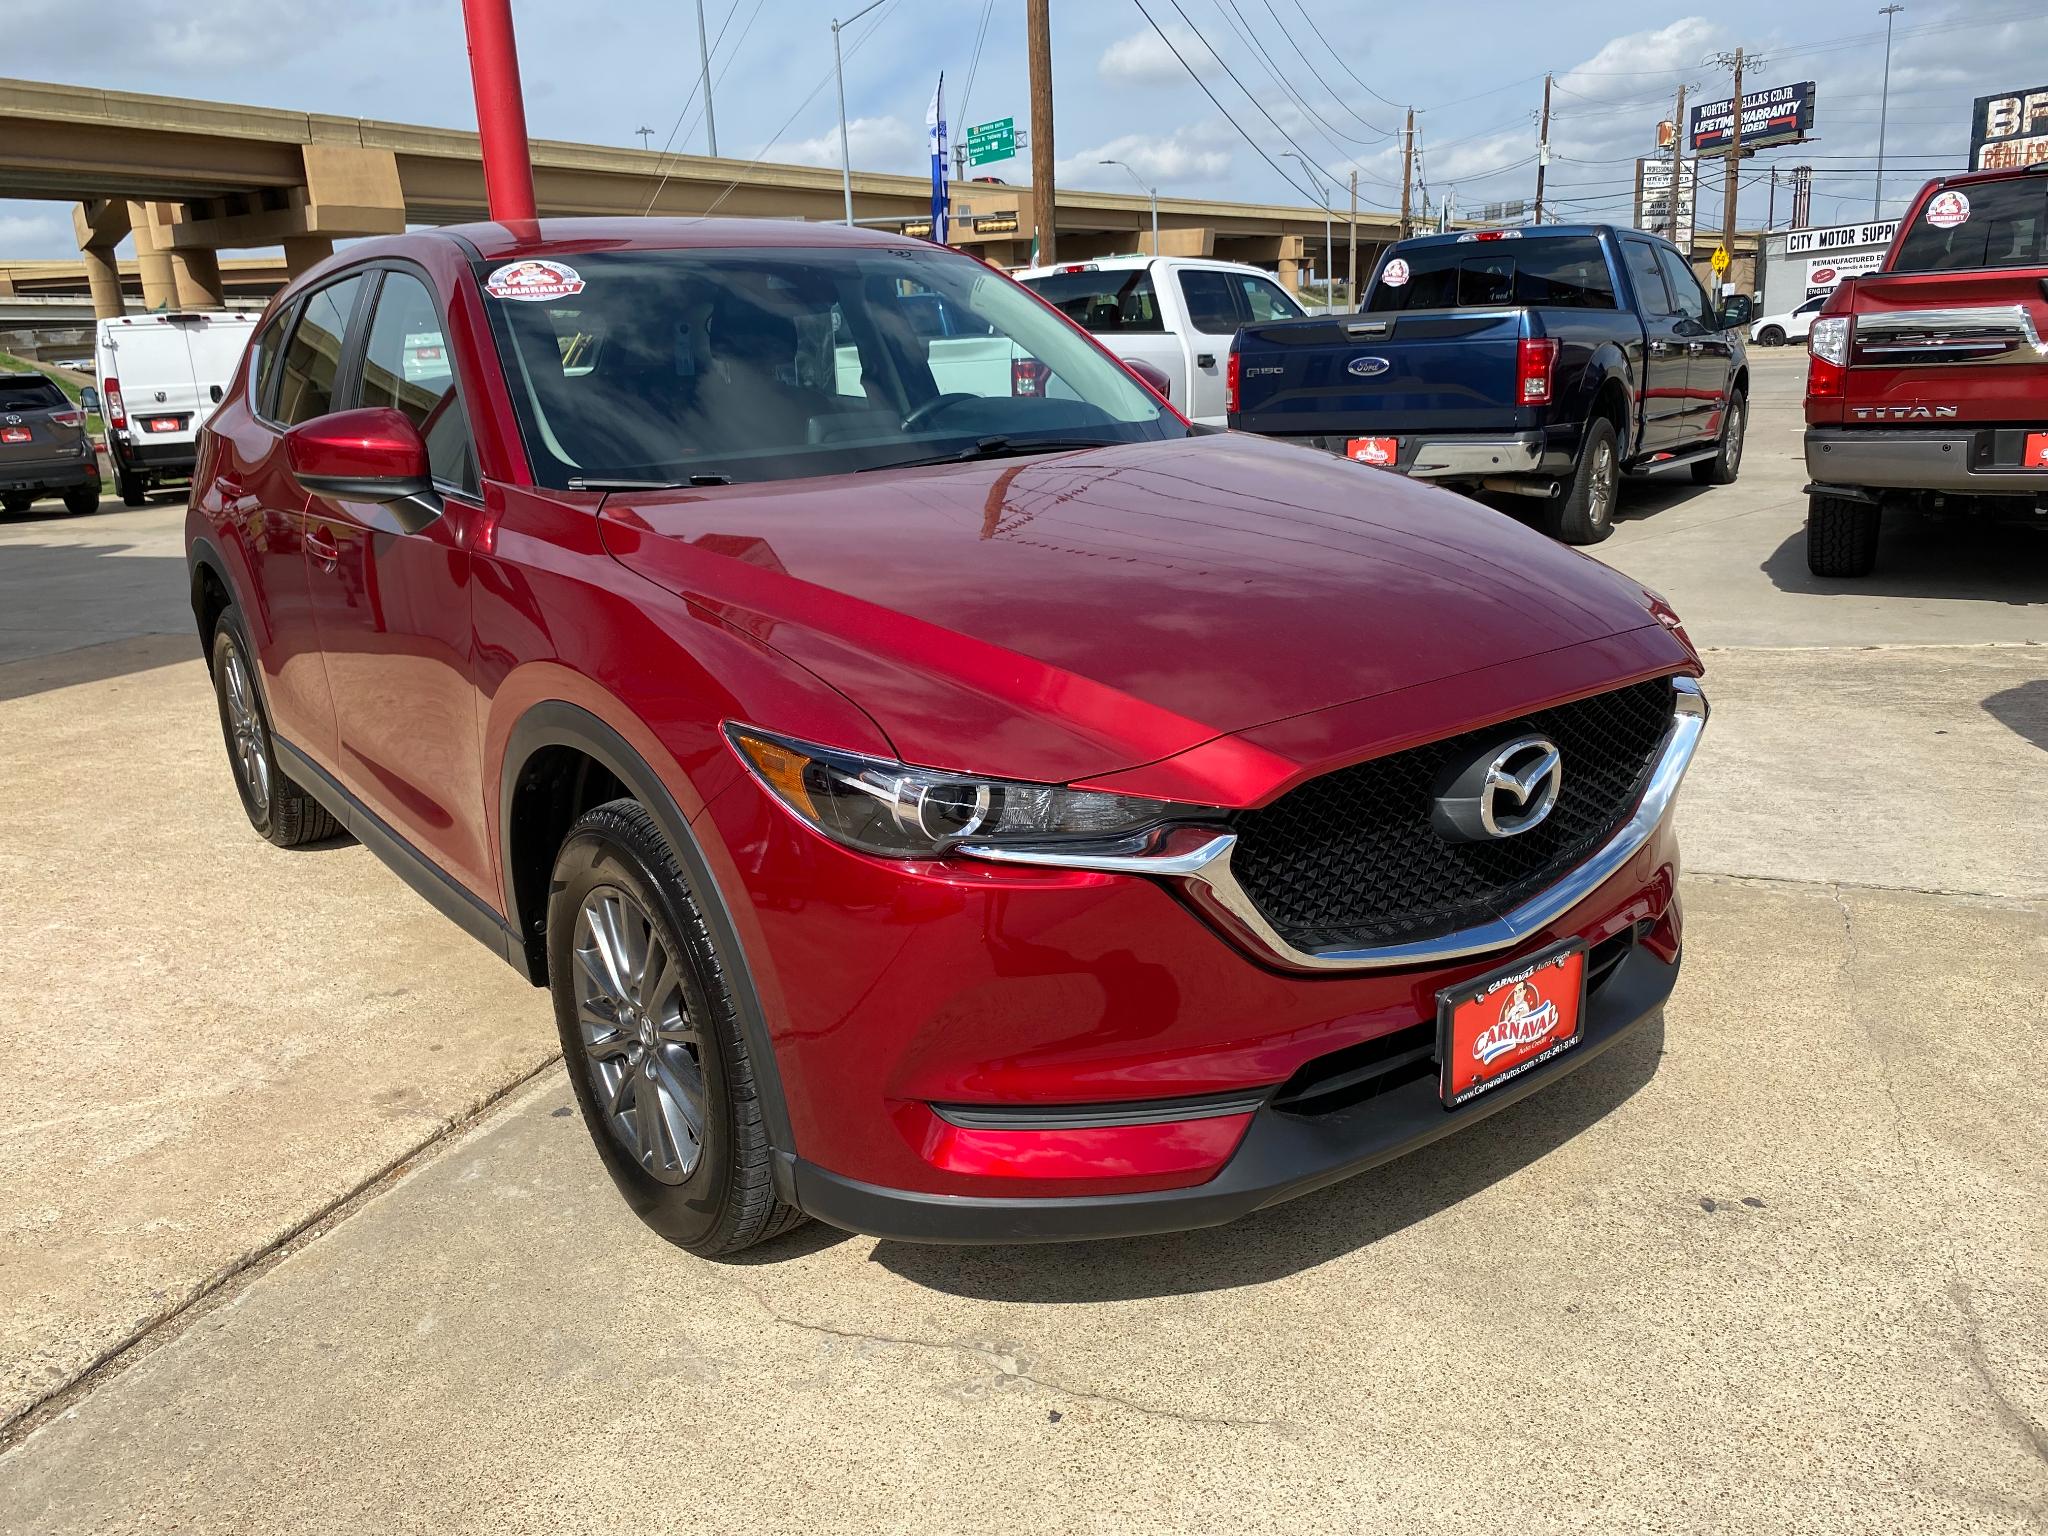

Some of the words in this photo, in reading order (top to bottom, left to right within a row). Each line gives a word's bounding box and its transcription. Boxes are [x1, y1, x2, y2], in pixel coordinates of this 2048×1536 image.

[1700, 102, 1728, 118] NORTH
[1741, 91, 1769, 109] ALLAS
[1770, 87, 1793, 102] CDJR
[1790, 233, 1812, 251] CITY
[1819, 228, 1855, 247] MOTOR
[1861, 223, 1899, 243] SUPPL
[1812, 255, 1875, 267] REMANUFACTURED
[497, 284, 575, 295] WARRANTY
[1808, 286, 1832, 295] ENGINE
[1852, 405, 1958, 419] TITAN
[1487, 965, 1535, 994] CARNAVAL
[1536, 958, 1552, 972] Auto
[1474, 1005, 1559, 1059] CARNAVAL
[1518, 1043, 1532, 1056] Auto
[1531, 1037, 1548, 1050] Credit
[1455, 1060, 1535, 1104] www.CarnavalAutos.com
